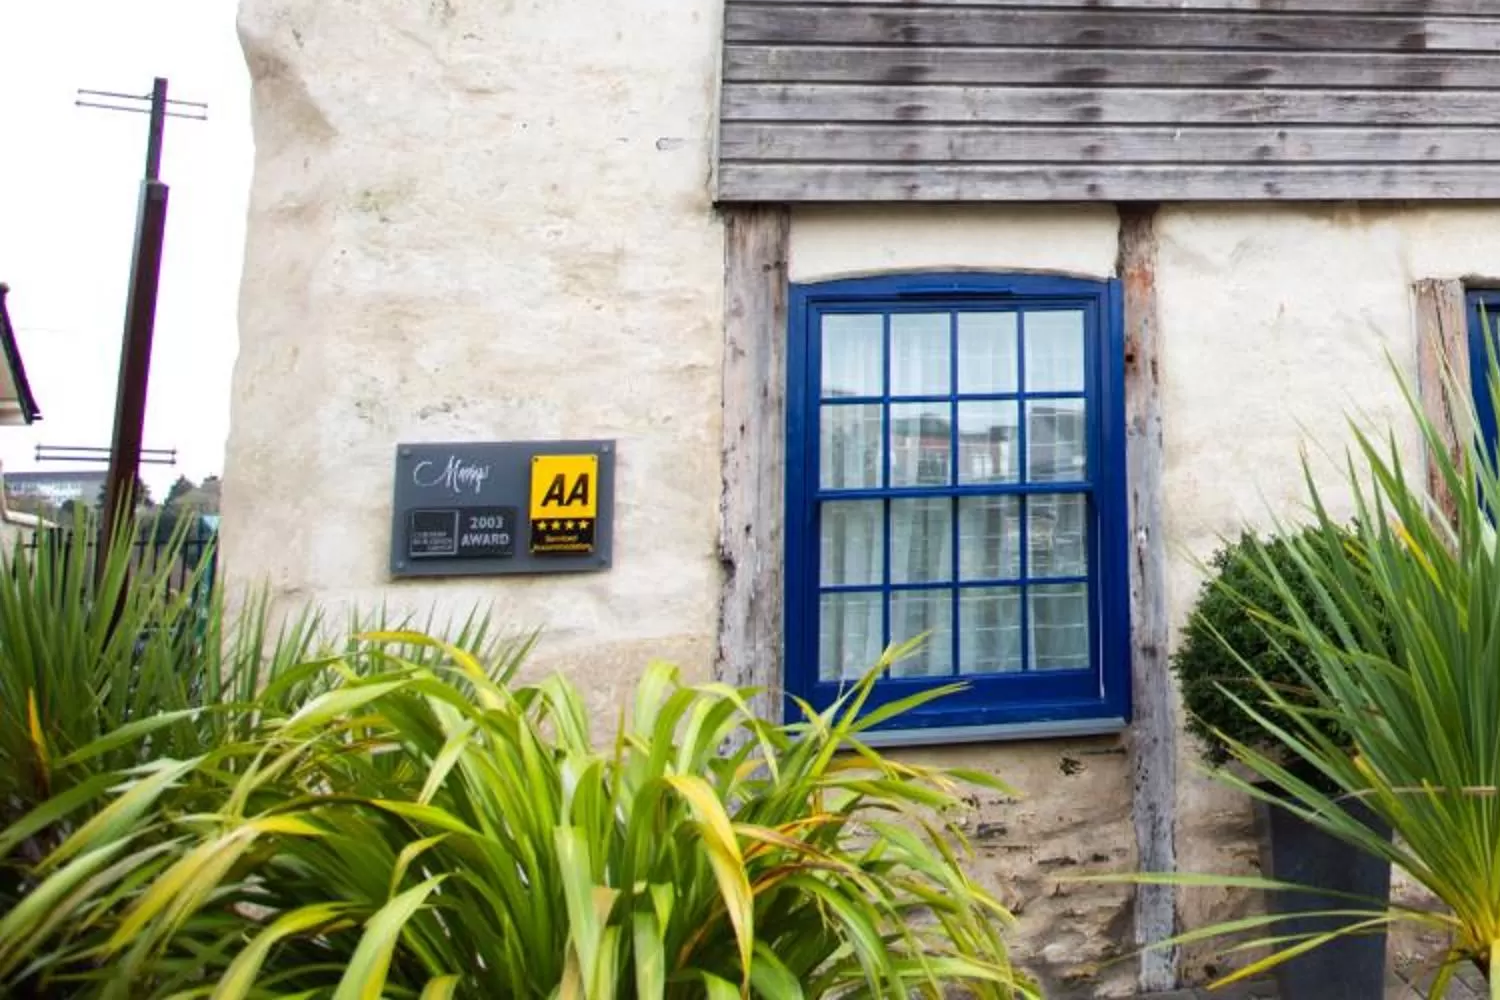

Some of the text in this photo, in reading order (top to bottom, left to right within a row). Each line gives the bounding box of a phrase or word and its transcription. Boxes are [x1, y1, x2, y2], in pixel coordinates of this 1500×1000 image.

[540, 473, 589, 507] AA
[469, 516, 504, 529] 2003
[461, 533, 510, 547] AWARD
